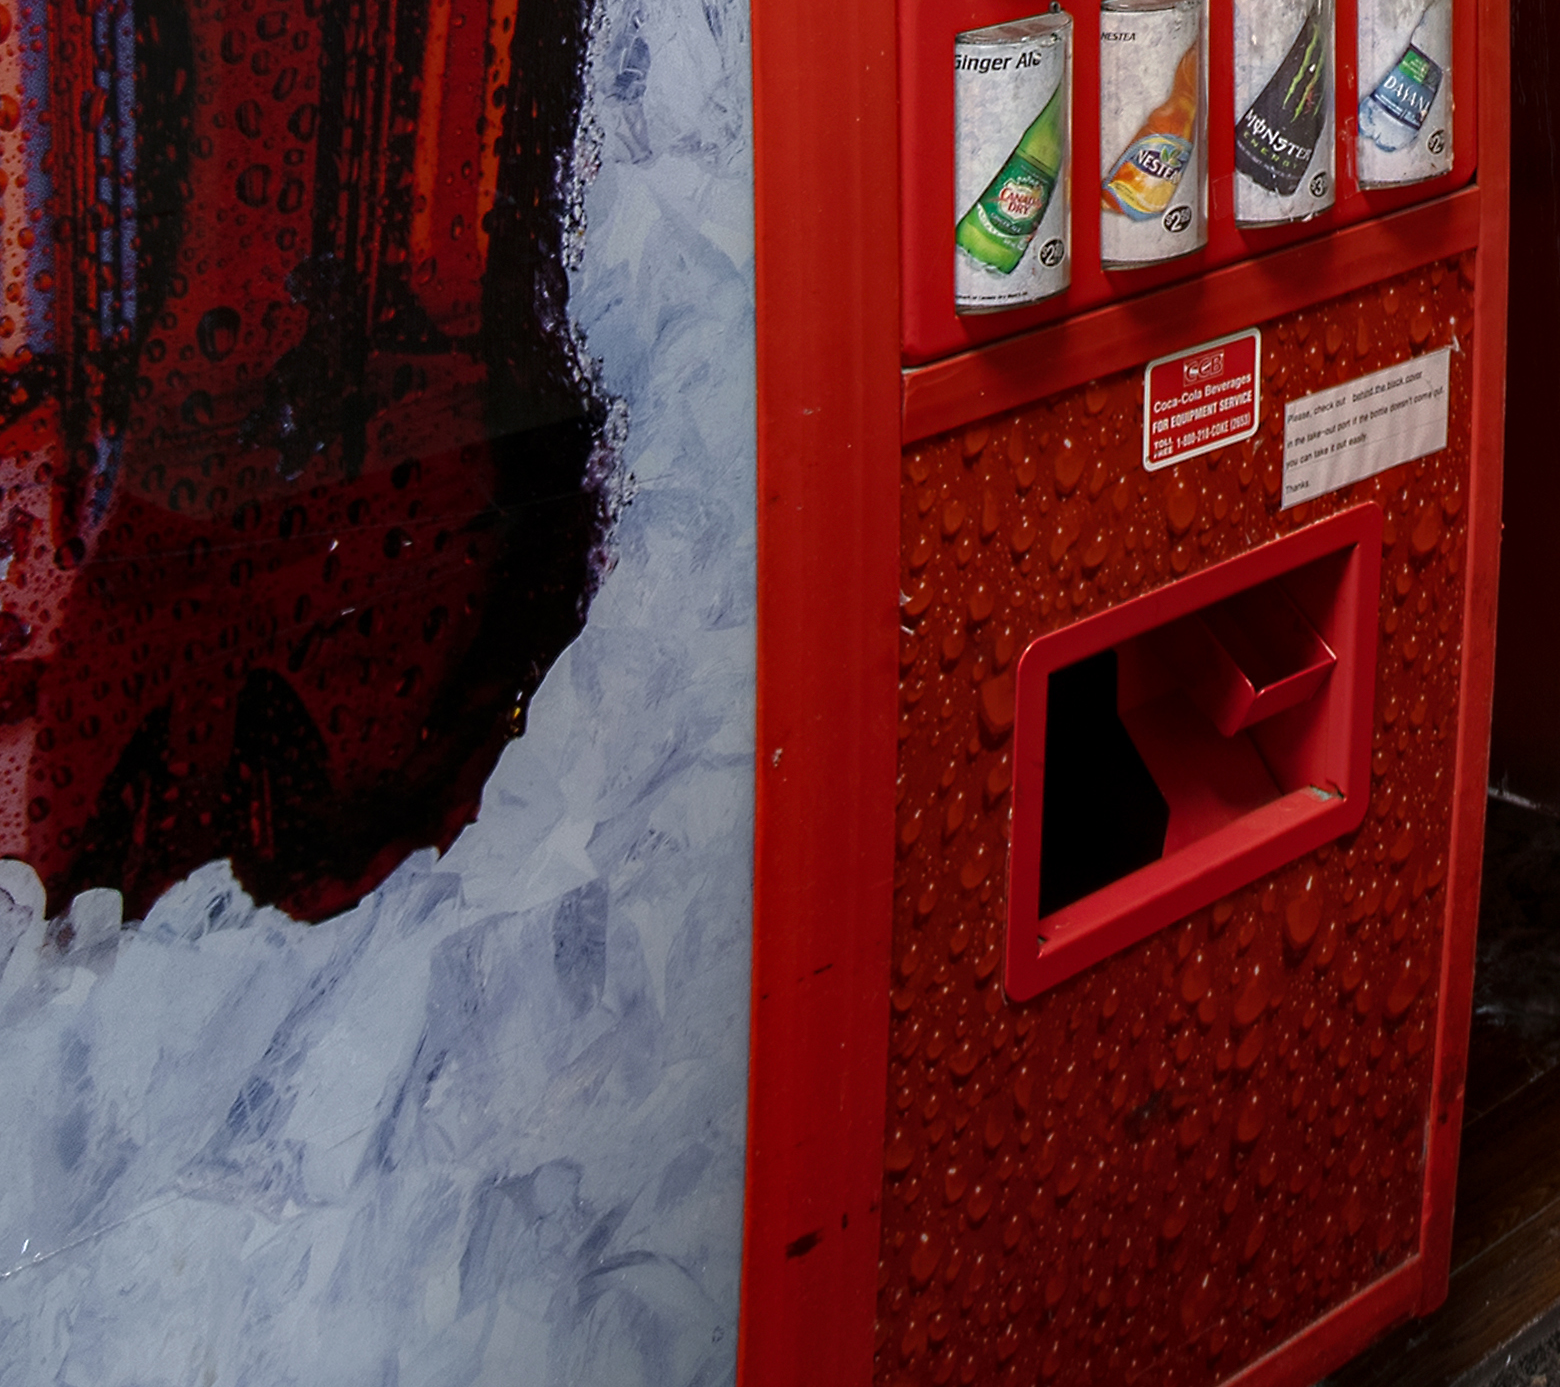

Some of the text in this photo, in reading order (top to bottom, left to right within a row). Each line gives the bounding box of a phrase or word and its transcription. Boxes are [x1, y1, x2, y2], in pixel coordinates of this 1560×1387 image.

[1101, 31, 1136, 43] NESTEA
[955, 53, 1012, 74] Ginger
[1384, 75, 1431, 113] DASANI
[1244, 131, 1297, 169] ENERGY
[1245, 109, 1313, 162] MONSTER
[1133, 149, 1182, 186] NESTEA
[1007, 202, 1031, 215] DRY
[1152, 389, 1251, 434] FOR EQUIPMENT SERVICE
[1154, 371, 1251, 414] Coca-Cola Beverages
[1287, 370, 1422, 425] Please, check out behind the black cover
[1287, 385, 1444, 449] in the take-out port if the bottle doesn't come out.
[1153, 436, 1173, 450] TOLL
[1286, 431, 1367, 470] you can take it out easily.
